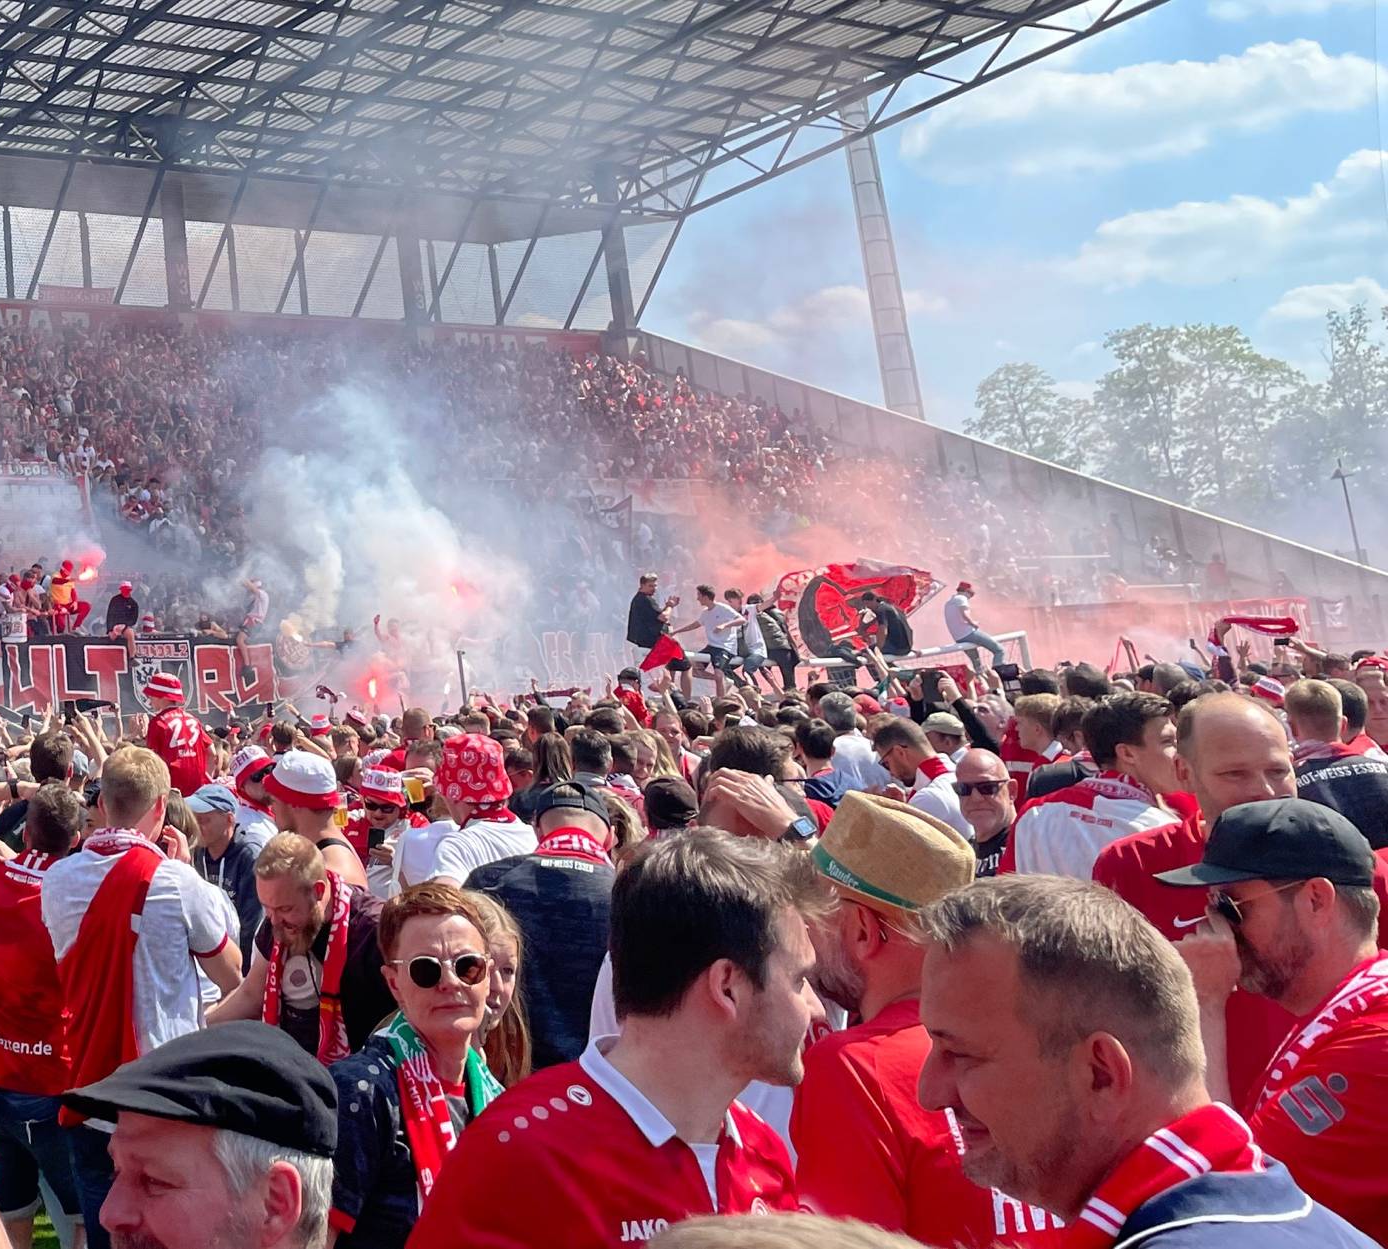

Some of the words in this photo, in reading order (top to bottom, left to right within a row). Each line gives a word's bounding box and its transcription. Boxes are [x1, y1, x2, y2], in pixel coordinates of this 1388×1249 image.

[167, 718, 201, 749] 23
[1296, 765, 1352, 788] ROT-WEISS
[1353, 761, 1388, 776] ESSEN
